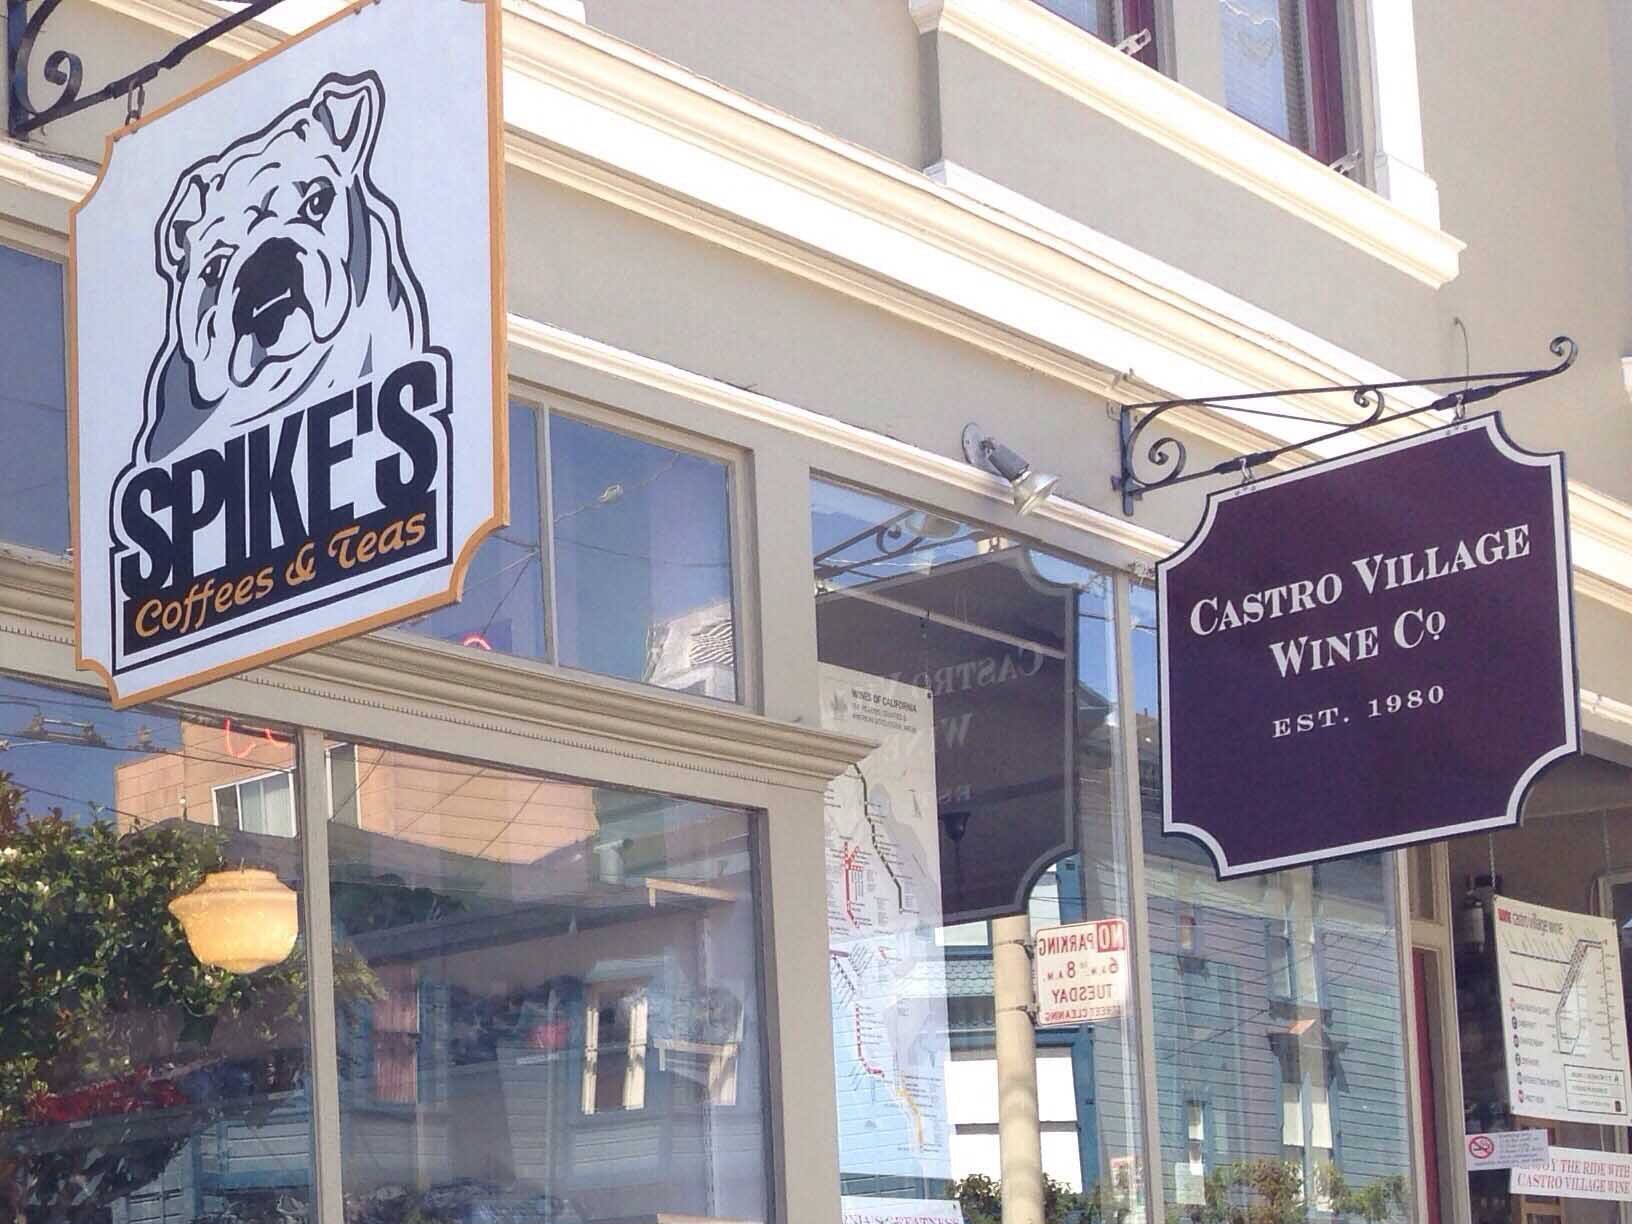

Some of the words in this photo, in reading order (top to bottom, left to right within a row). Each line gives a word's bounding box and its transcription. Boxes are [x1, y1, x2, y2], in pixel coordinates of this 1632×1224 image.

[121, 360, 437, 599] SPIKE'S
[135, 564, 275, 638] Coffees
[285, 542, 317, 587] &
[328, 511, 427, 570] Teas
[1190, 572, 1343, 636] CASTRO
[1352, 524, 1531, 595] VILLAGE
[1269, 626, 1379, 679] WINE
[1272, 707, 1351, 738] EST.
[1368, 684, 1445, 718] 1980
[1517, 1173, 1562, 1189] CASTRO
[1564, 1176, 1606, 1192] VILLAGE
[1561, 1159, 1581, 1174] THE
[1583, 1161, 1606, 1176] RIDE
